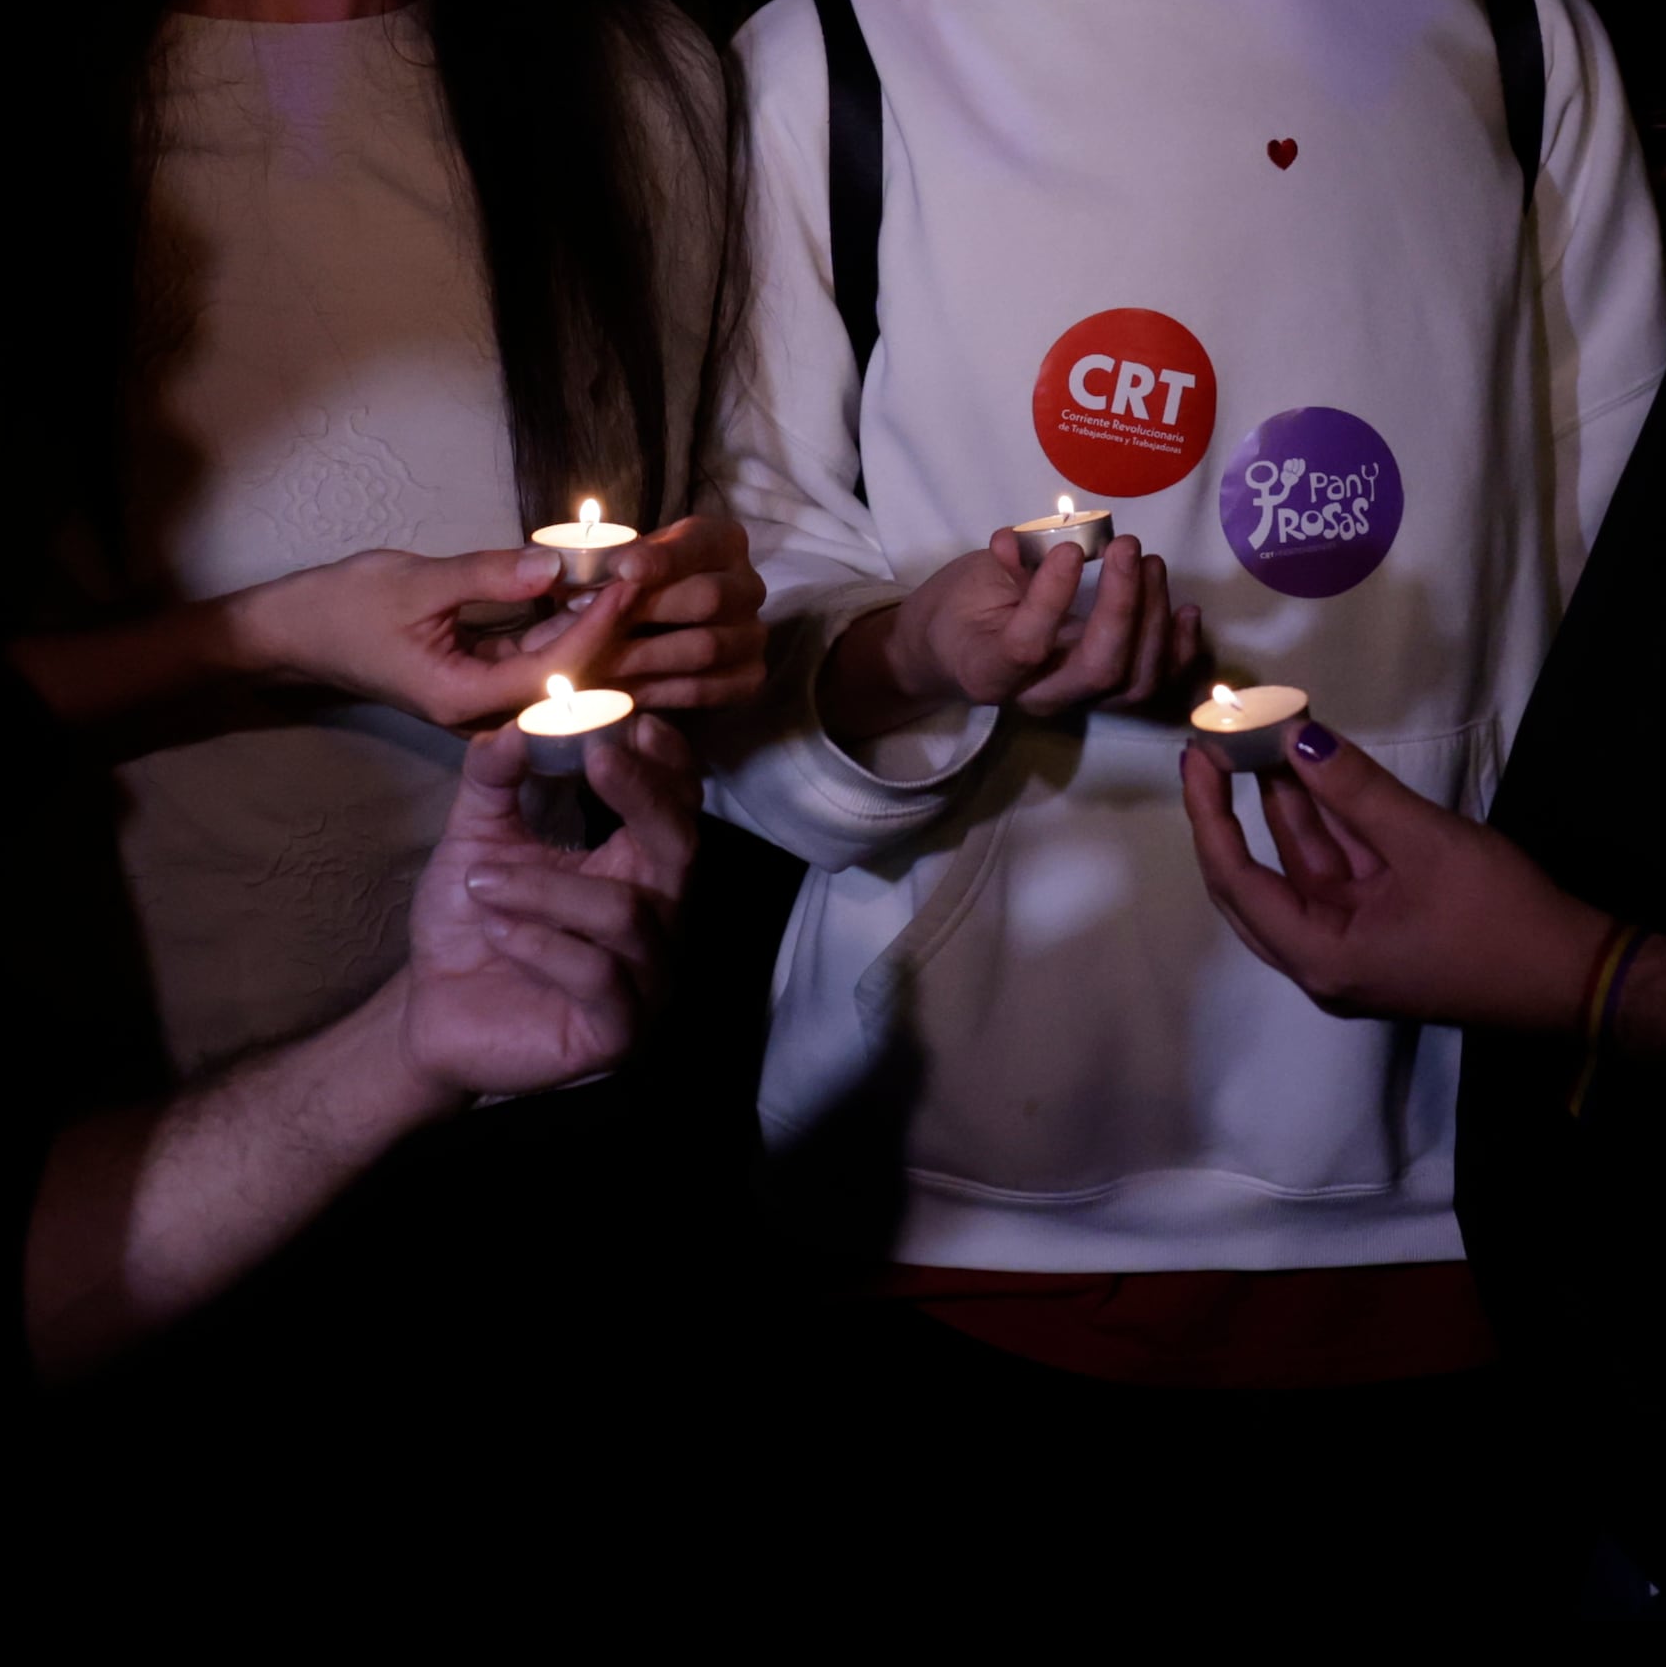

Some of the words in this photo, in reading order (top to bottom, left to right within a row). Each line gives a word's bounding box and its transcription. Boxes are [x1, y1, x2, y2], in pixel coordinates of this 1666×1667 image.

[1068, 353, 1196, 425] CRT
[1058, 422, 1070, 432] de
[1071, 423, 1123, 443] Trabajadores
[1061, 408, 1110, 428] Corriente
[1112, 418, 1185, 443] Revolucionaria
